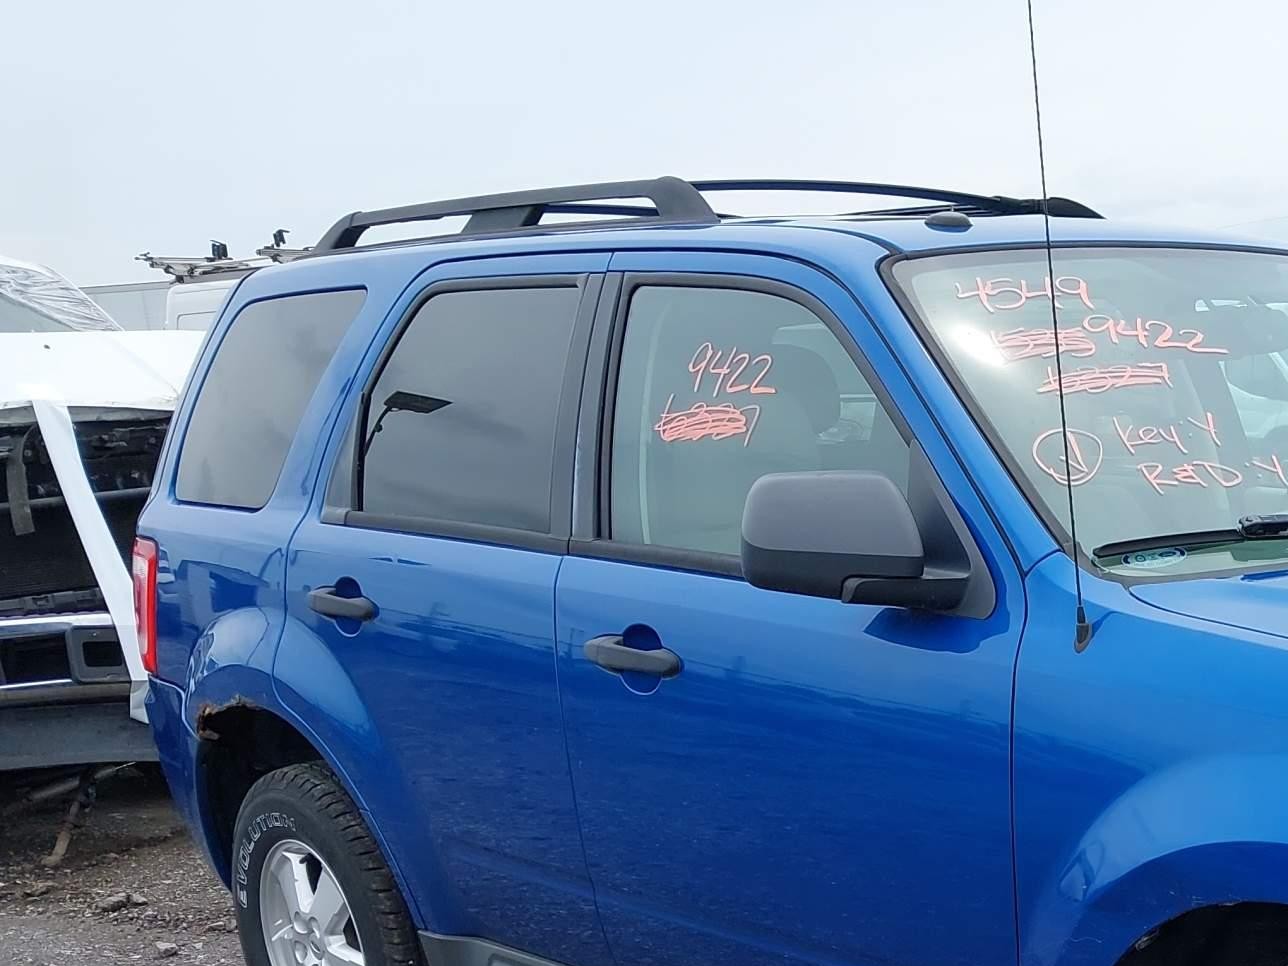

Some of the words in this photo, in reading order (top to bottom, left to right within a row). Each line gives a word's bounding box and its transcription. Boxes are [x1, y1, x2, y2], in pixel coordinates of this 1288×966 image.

[955, 276, 1094, 313] 4549
[1082, 314, 1230, 354] 9422
[688, 342, 776, 398] 9422
